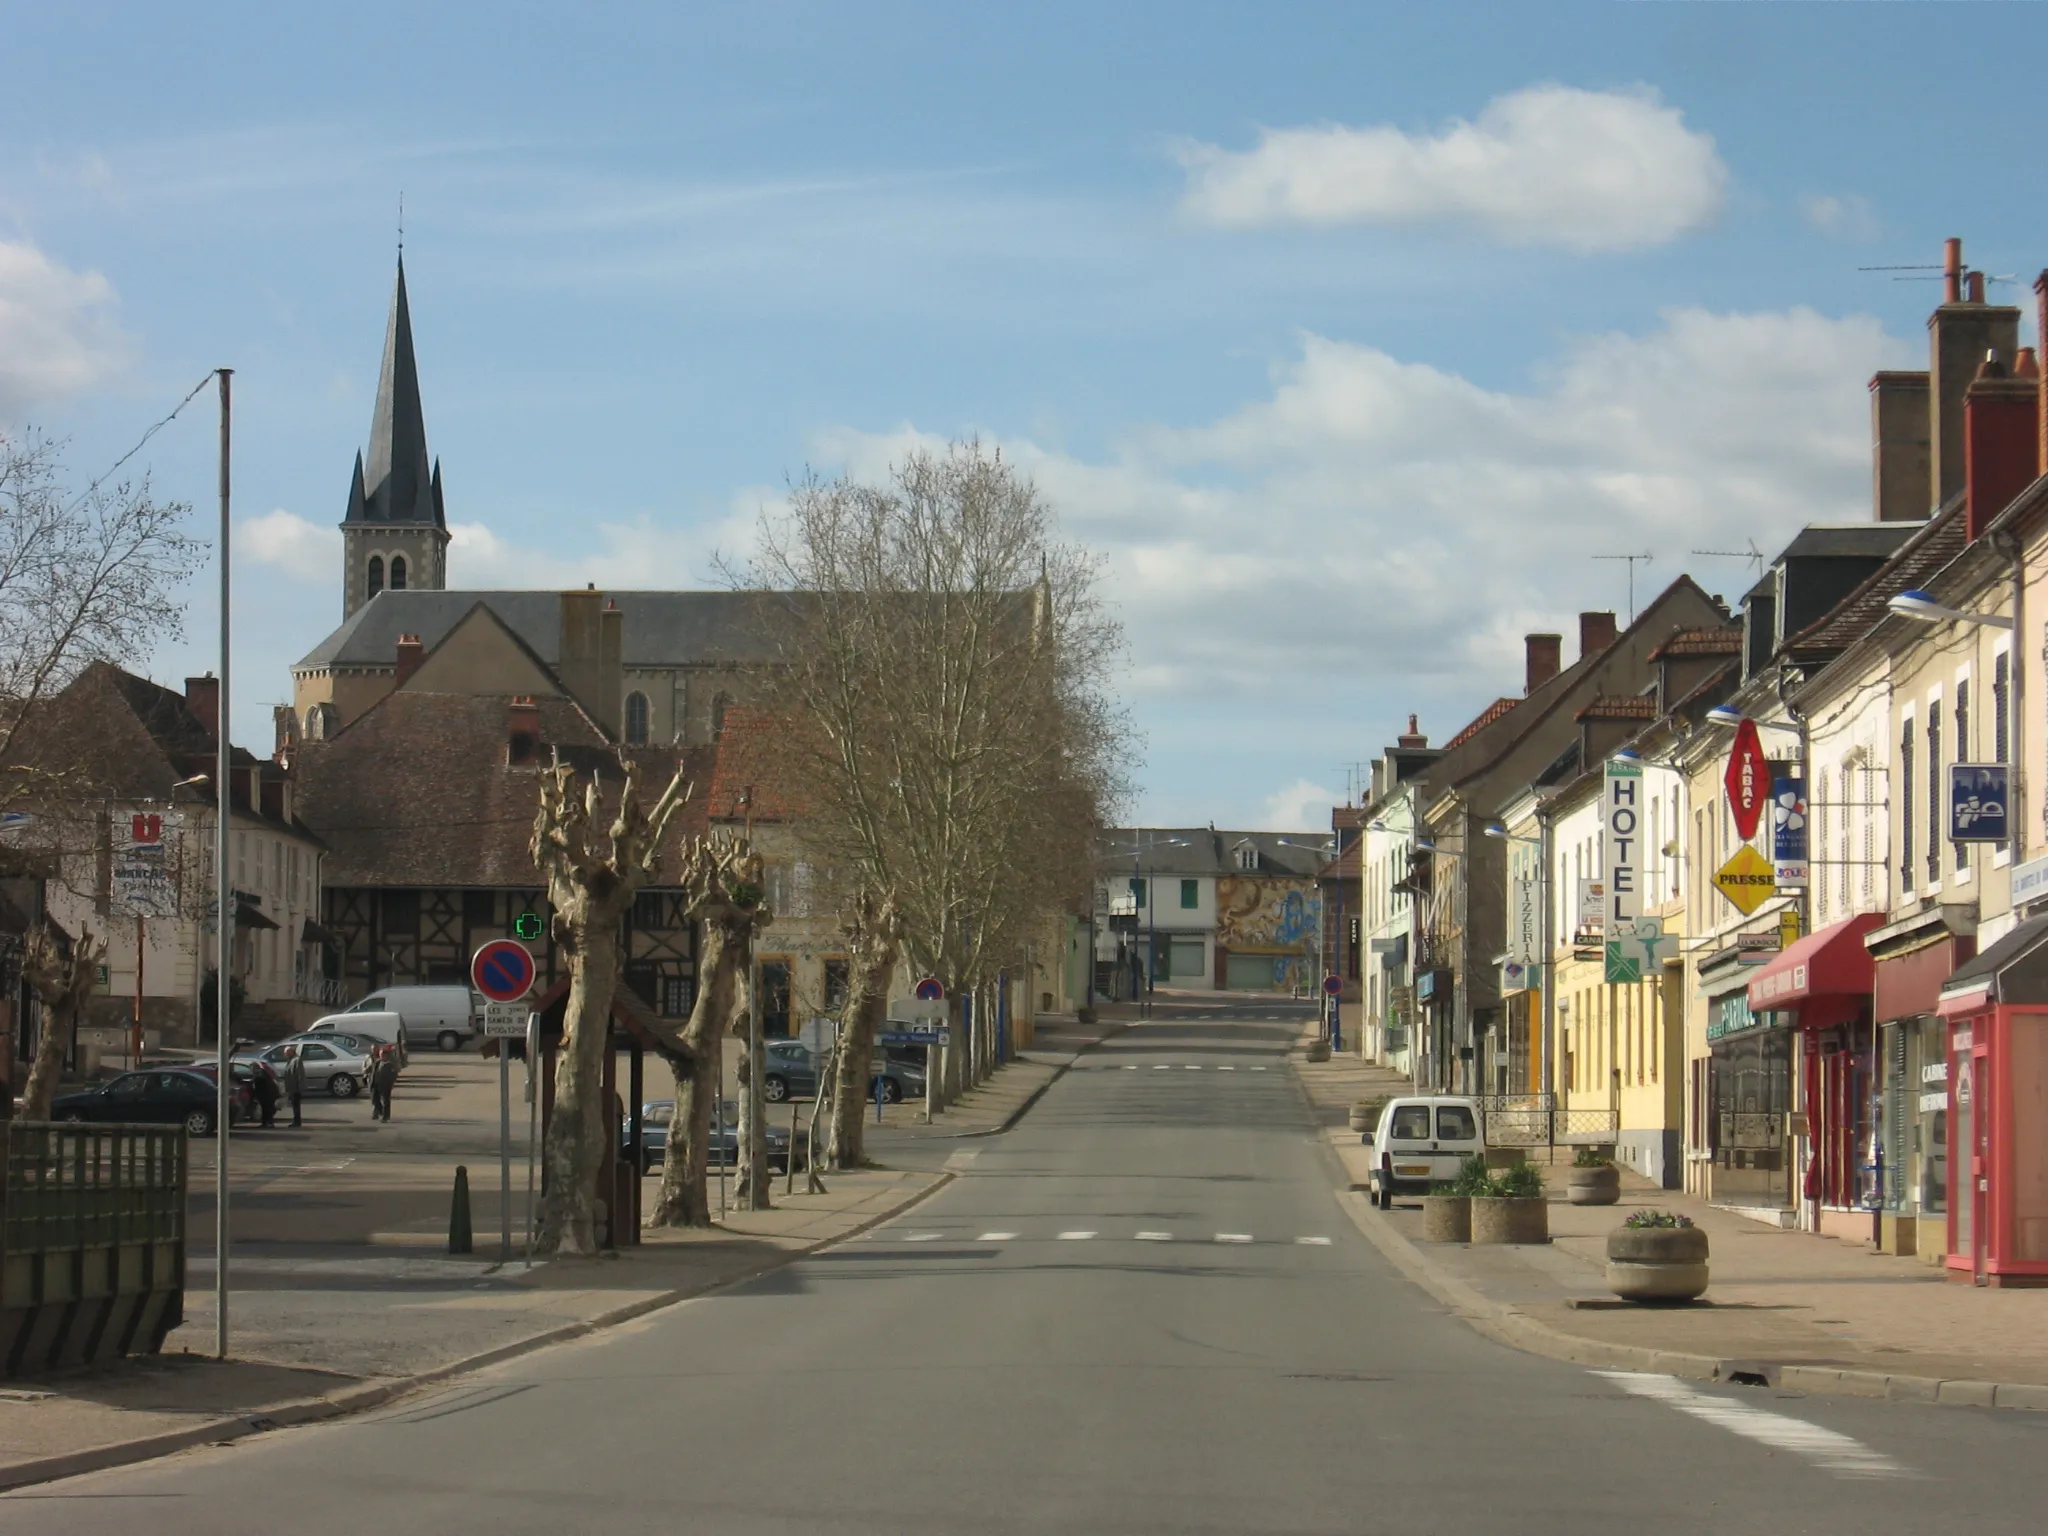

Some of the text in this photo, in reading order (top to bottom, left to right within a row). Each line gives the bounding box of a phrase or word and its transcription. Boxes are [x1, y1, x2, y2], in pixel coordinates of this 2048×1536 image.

[1742, 752, 1754, 809] TABAC
[1611, 780, 1637, 922] HOTEL
[1777, 867, 1808, 879] LOTO
[1719, 874, 1775, 886] PRESSE
[1521, 882, 1532, 963] PIZZERIA
